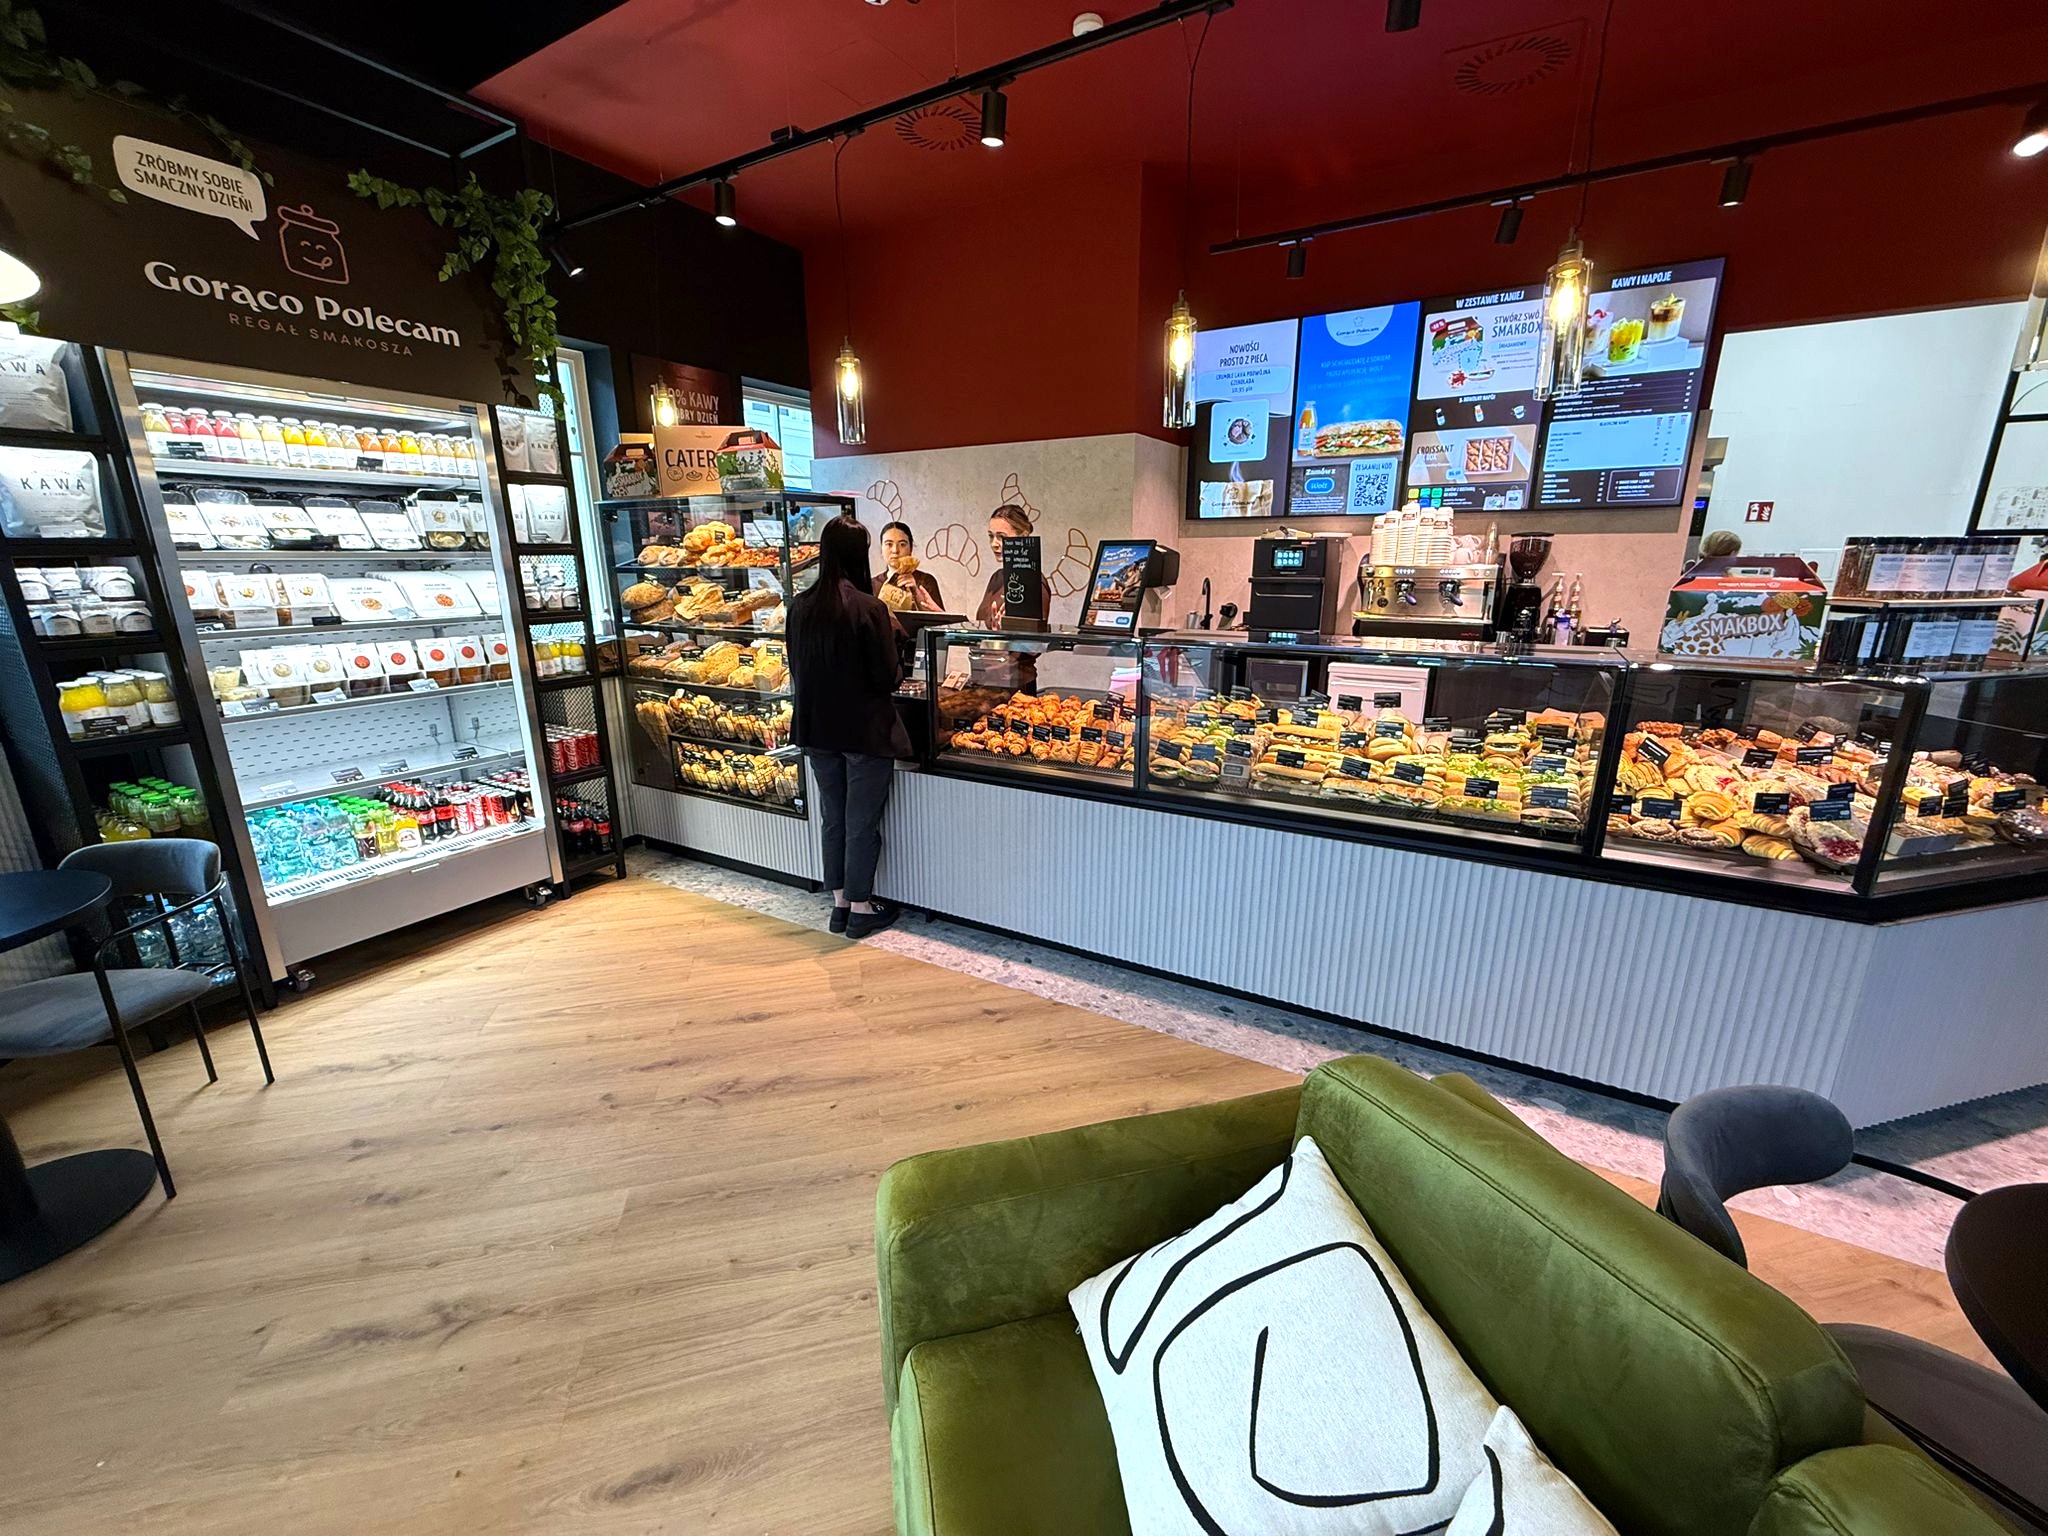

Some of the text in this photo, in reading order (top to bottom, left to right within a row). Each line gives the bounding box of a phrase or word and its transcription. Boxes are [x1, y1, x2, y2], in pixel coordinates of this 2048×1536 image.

[136, 151, 243, 190] ZRÓBMY SOBIE
[134, 168, 253, 213] SMACZNY DZIEŃ!
[1611, 277, 1636, 288] KAWY
[1641, 271, 1672, 285] NAPOJE
[144, 261, 461, 347] Gorąco Polecam
[1456, 291, 1525, 308] W ZESTAWIE TANIEJ
[1494, 310, 1540, 325] STWÓRZ SWÓ
[228, 312, 413, 357] REGAŁ SMAKOSZA
[1492, 321, 1542, 338] SMAKBOX
[1229, 341, 1260, 354] NOWOŚCI
[1220, 353, 1268, 367] PROSTO Z PIECA
[689, 391, 719, 411] KAWY
[696, 411, 719, 424] DZIEŃ
[1417, 444, 1455, 454] CROISSANT
[665, 449, 716, 468] CATER
[20, 477, 86, 491] KAWA
[1700, 614, 1782, 638] SMAKBOX
